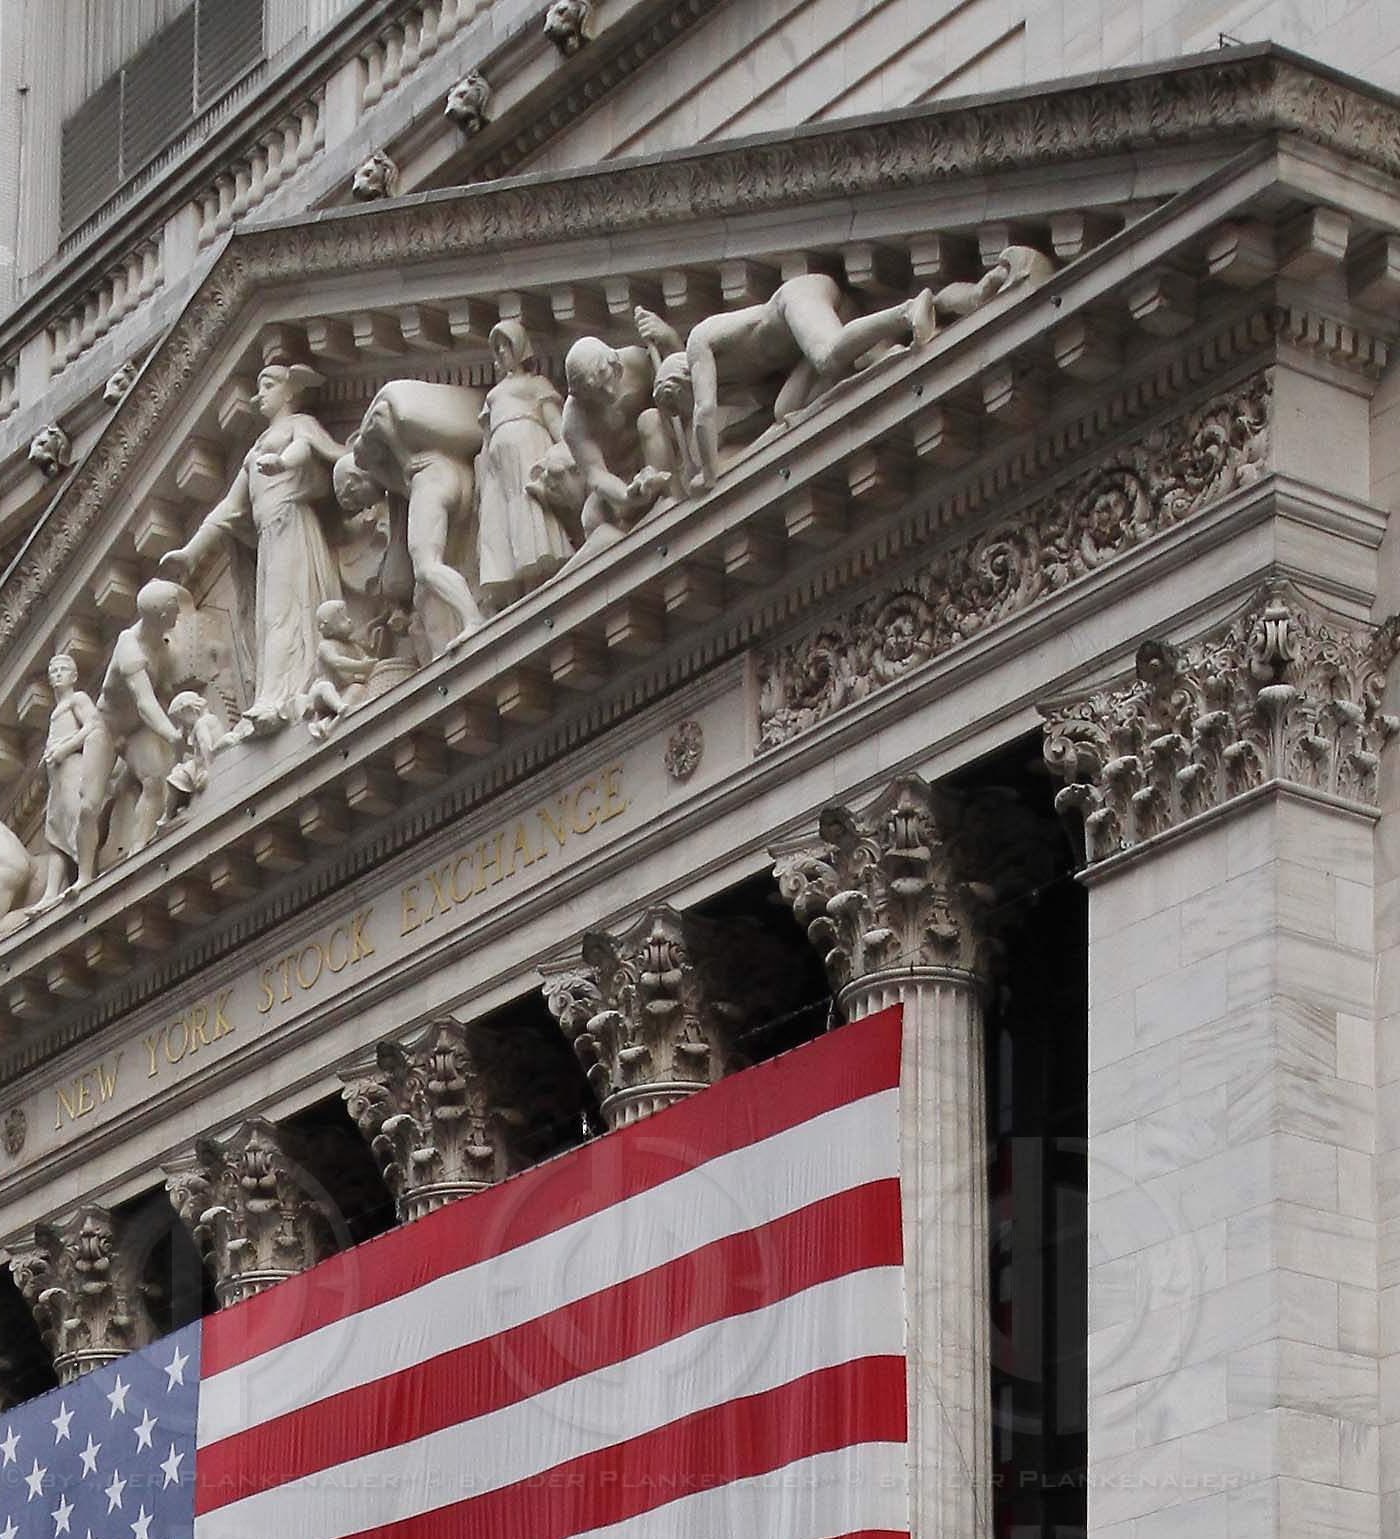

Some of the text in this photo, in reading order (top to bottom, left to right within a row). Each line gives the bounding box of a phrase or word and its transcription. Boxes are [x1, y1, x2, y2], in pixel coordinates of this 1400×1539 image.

[53, 763, 630, 1131] NEW YORK STOCK EXCHANGE
